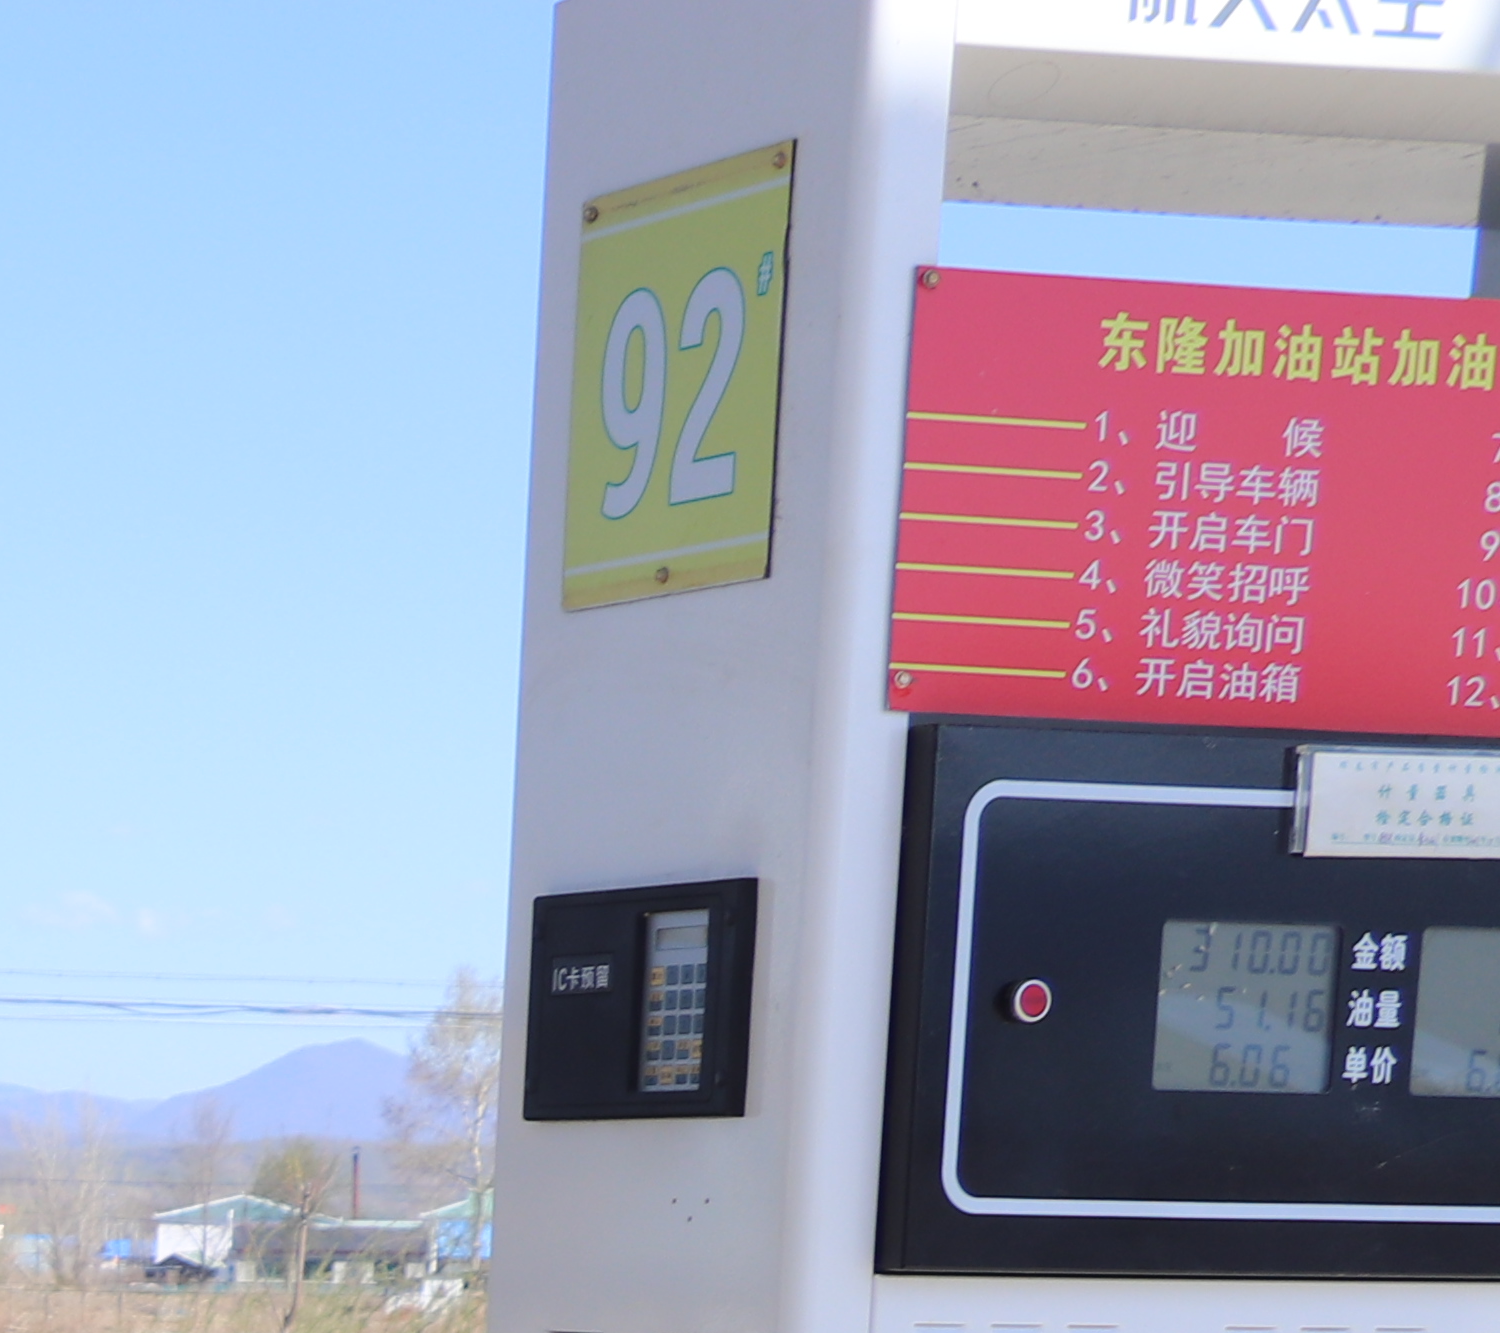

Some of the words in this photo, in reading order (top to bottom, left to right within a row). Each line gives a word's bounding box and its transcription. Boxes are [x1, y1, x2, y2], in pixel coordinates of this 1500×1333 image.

[1098, 311, 1497, 391] 东隆加油站加油
[1189, 925, 1332, 976] 310.00
[1351, 931, 1409, 971] 金额
[1346, 988, 1403, 1029] 油量
[1208, 1043, 1291, 1088] 6.06
[1341, 1046, 1398, 1085] 单价
